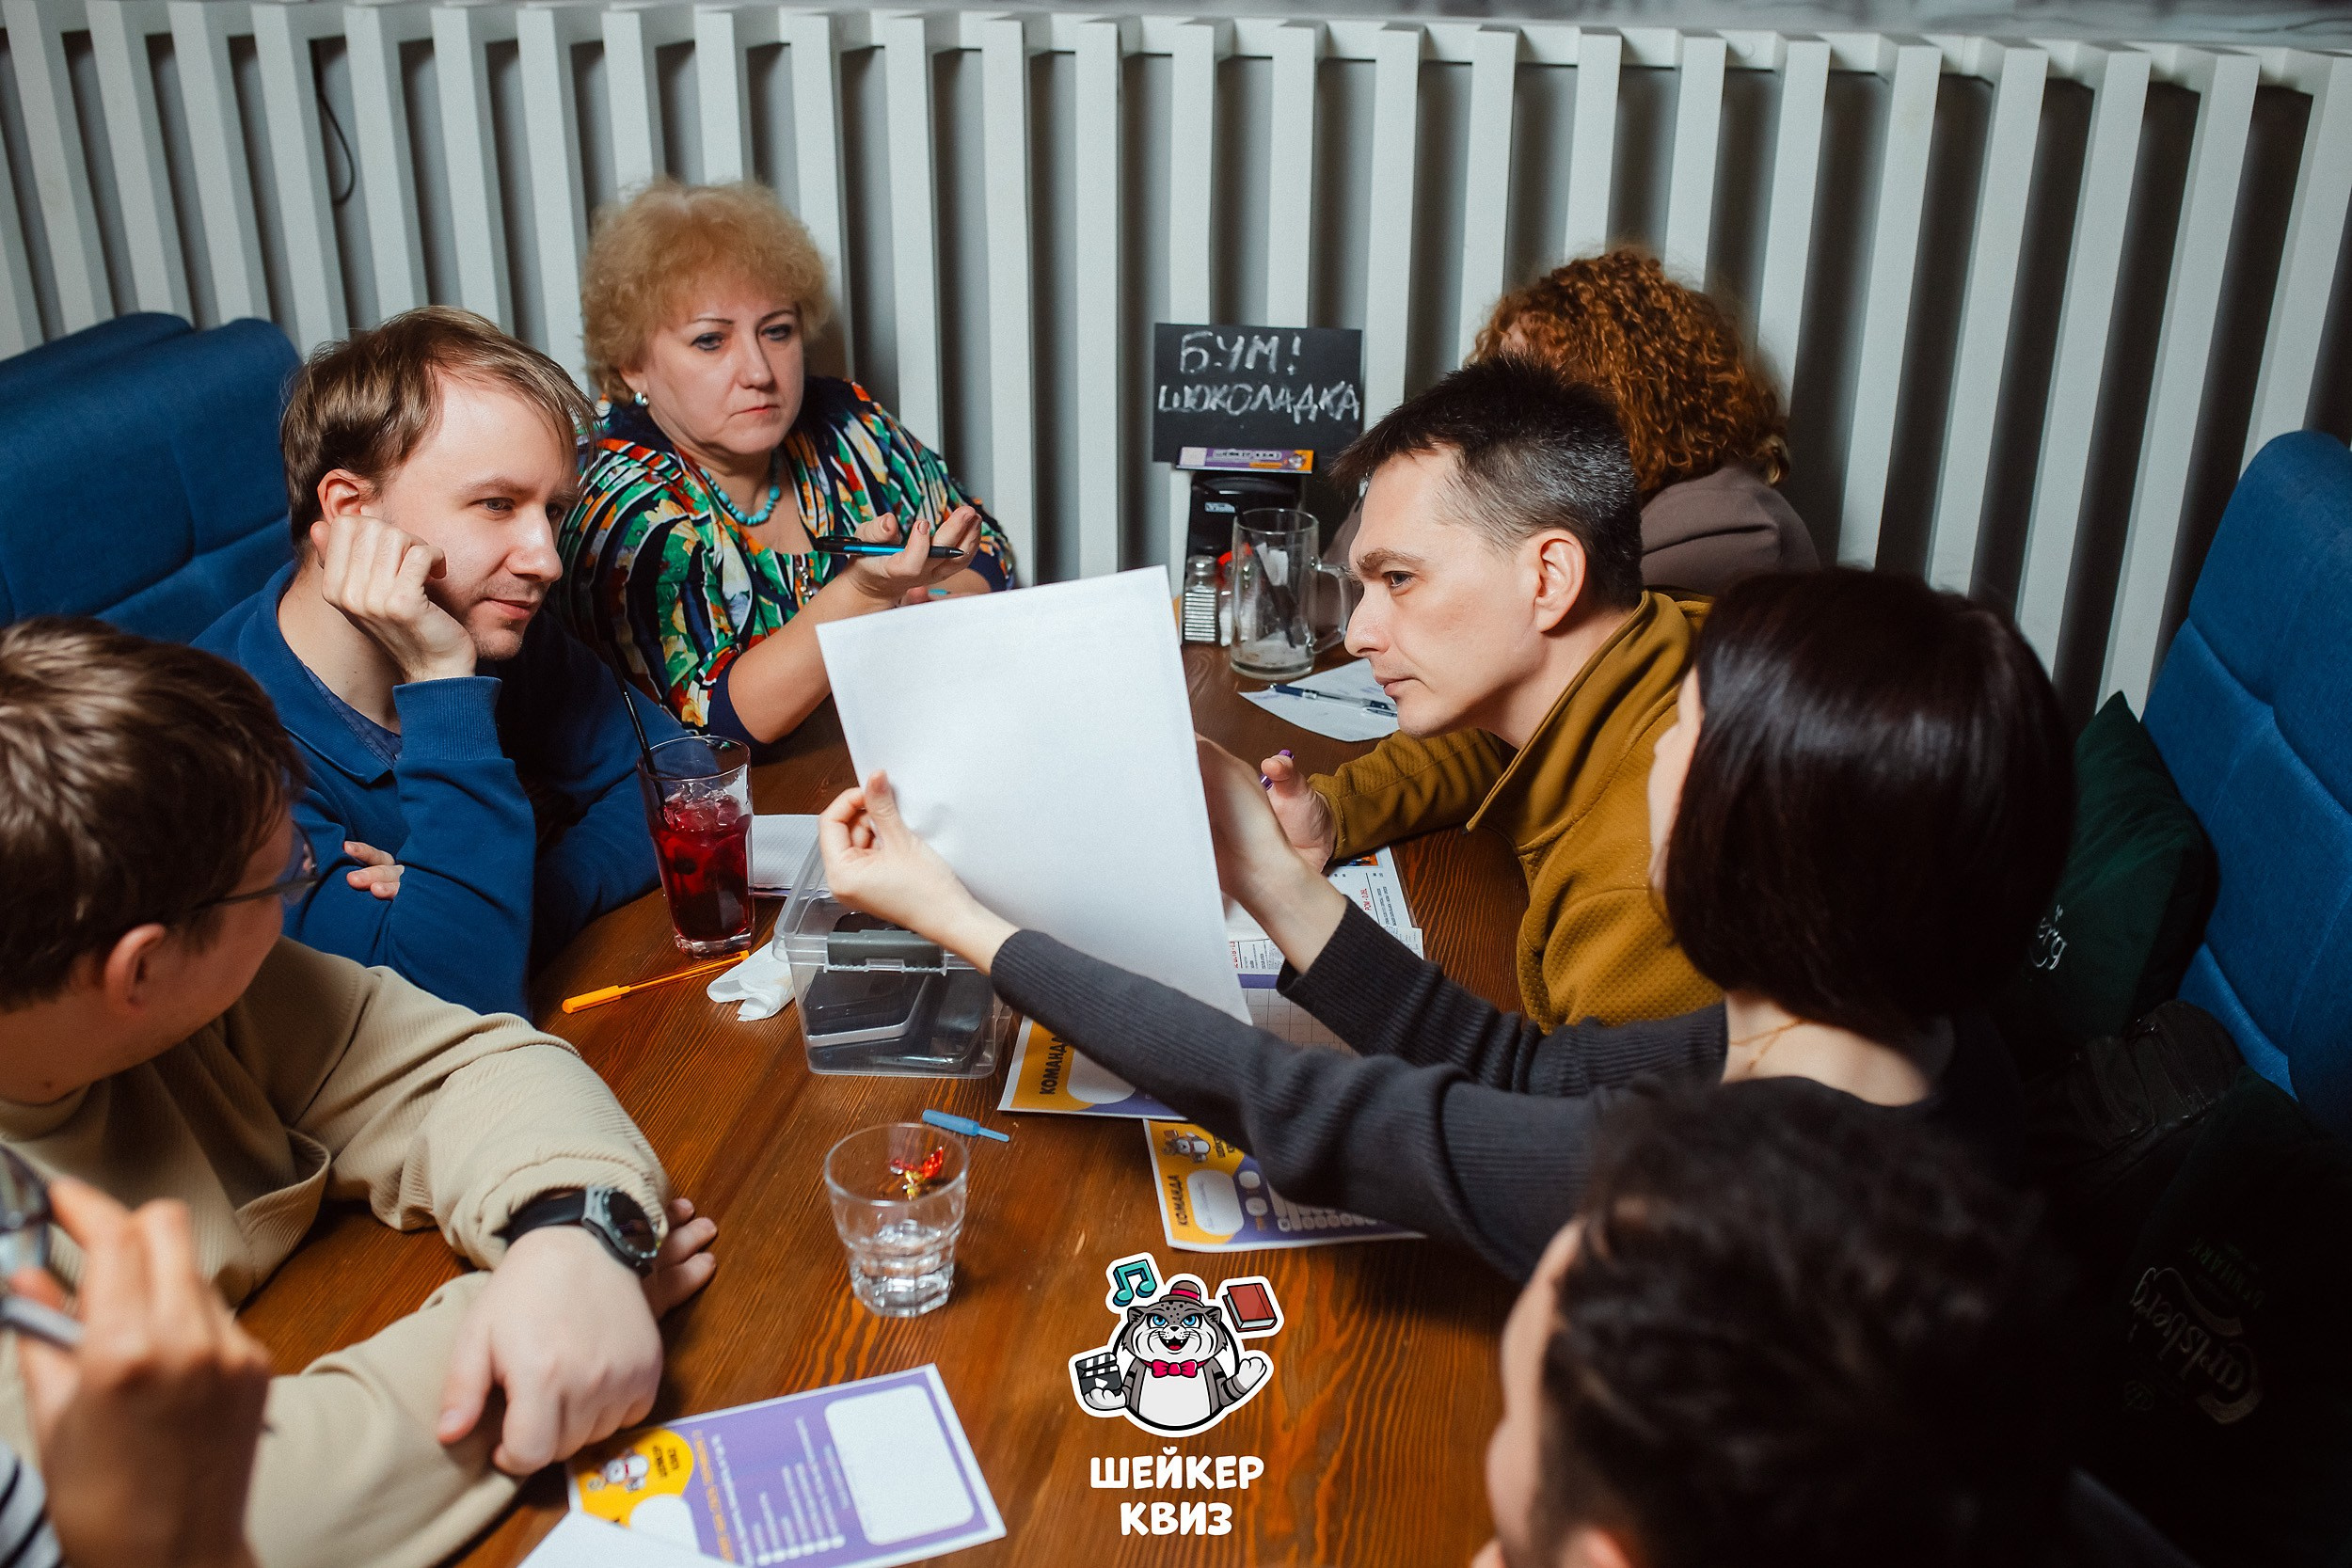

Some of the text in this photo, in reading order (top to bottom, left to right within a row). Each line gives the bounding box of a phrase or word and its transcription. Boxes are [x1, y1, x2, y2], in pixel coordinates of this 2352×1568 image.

[1180, 330, 1302, 375] БУМ!
[1157, 380, 1360, 425] ШОКОЛАДКА
[1168, 1174, 1188, 1226] КОМАНДА
[2129, 1266, 2264, 1425] Carlsberg
